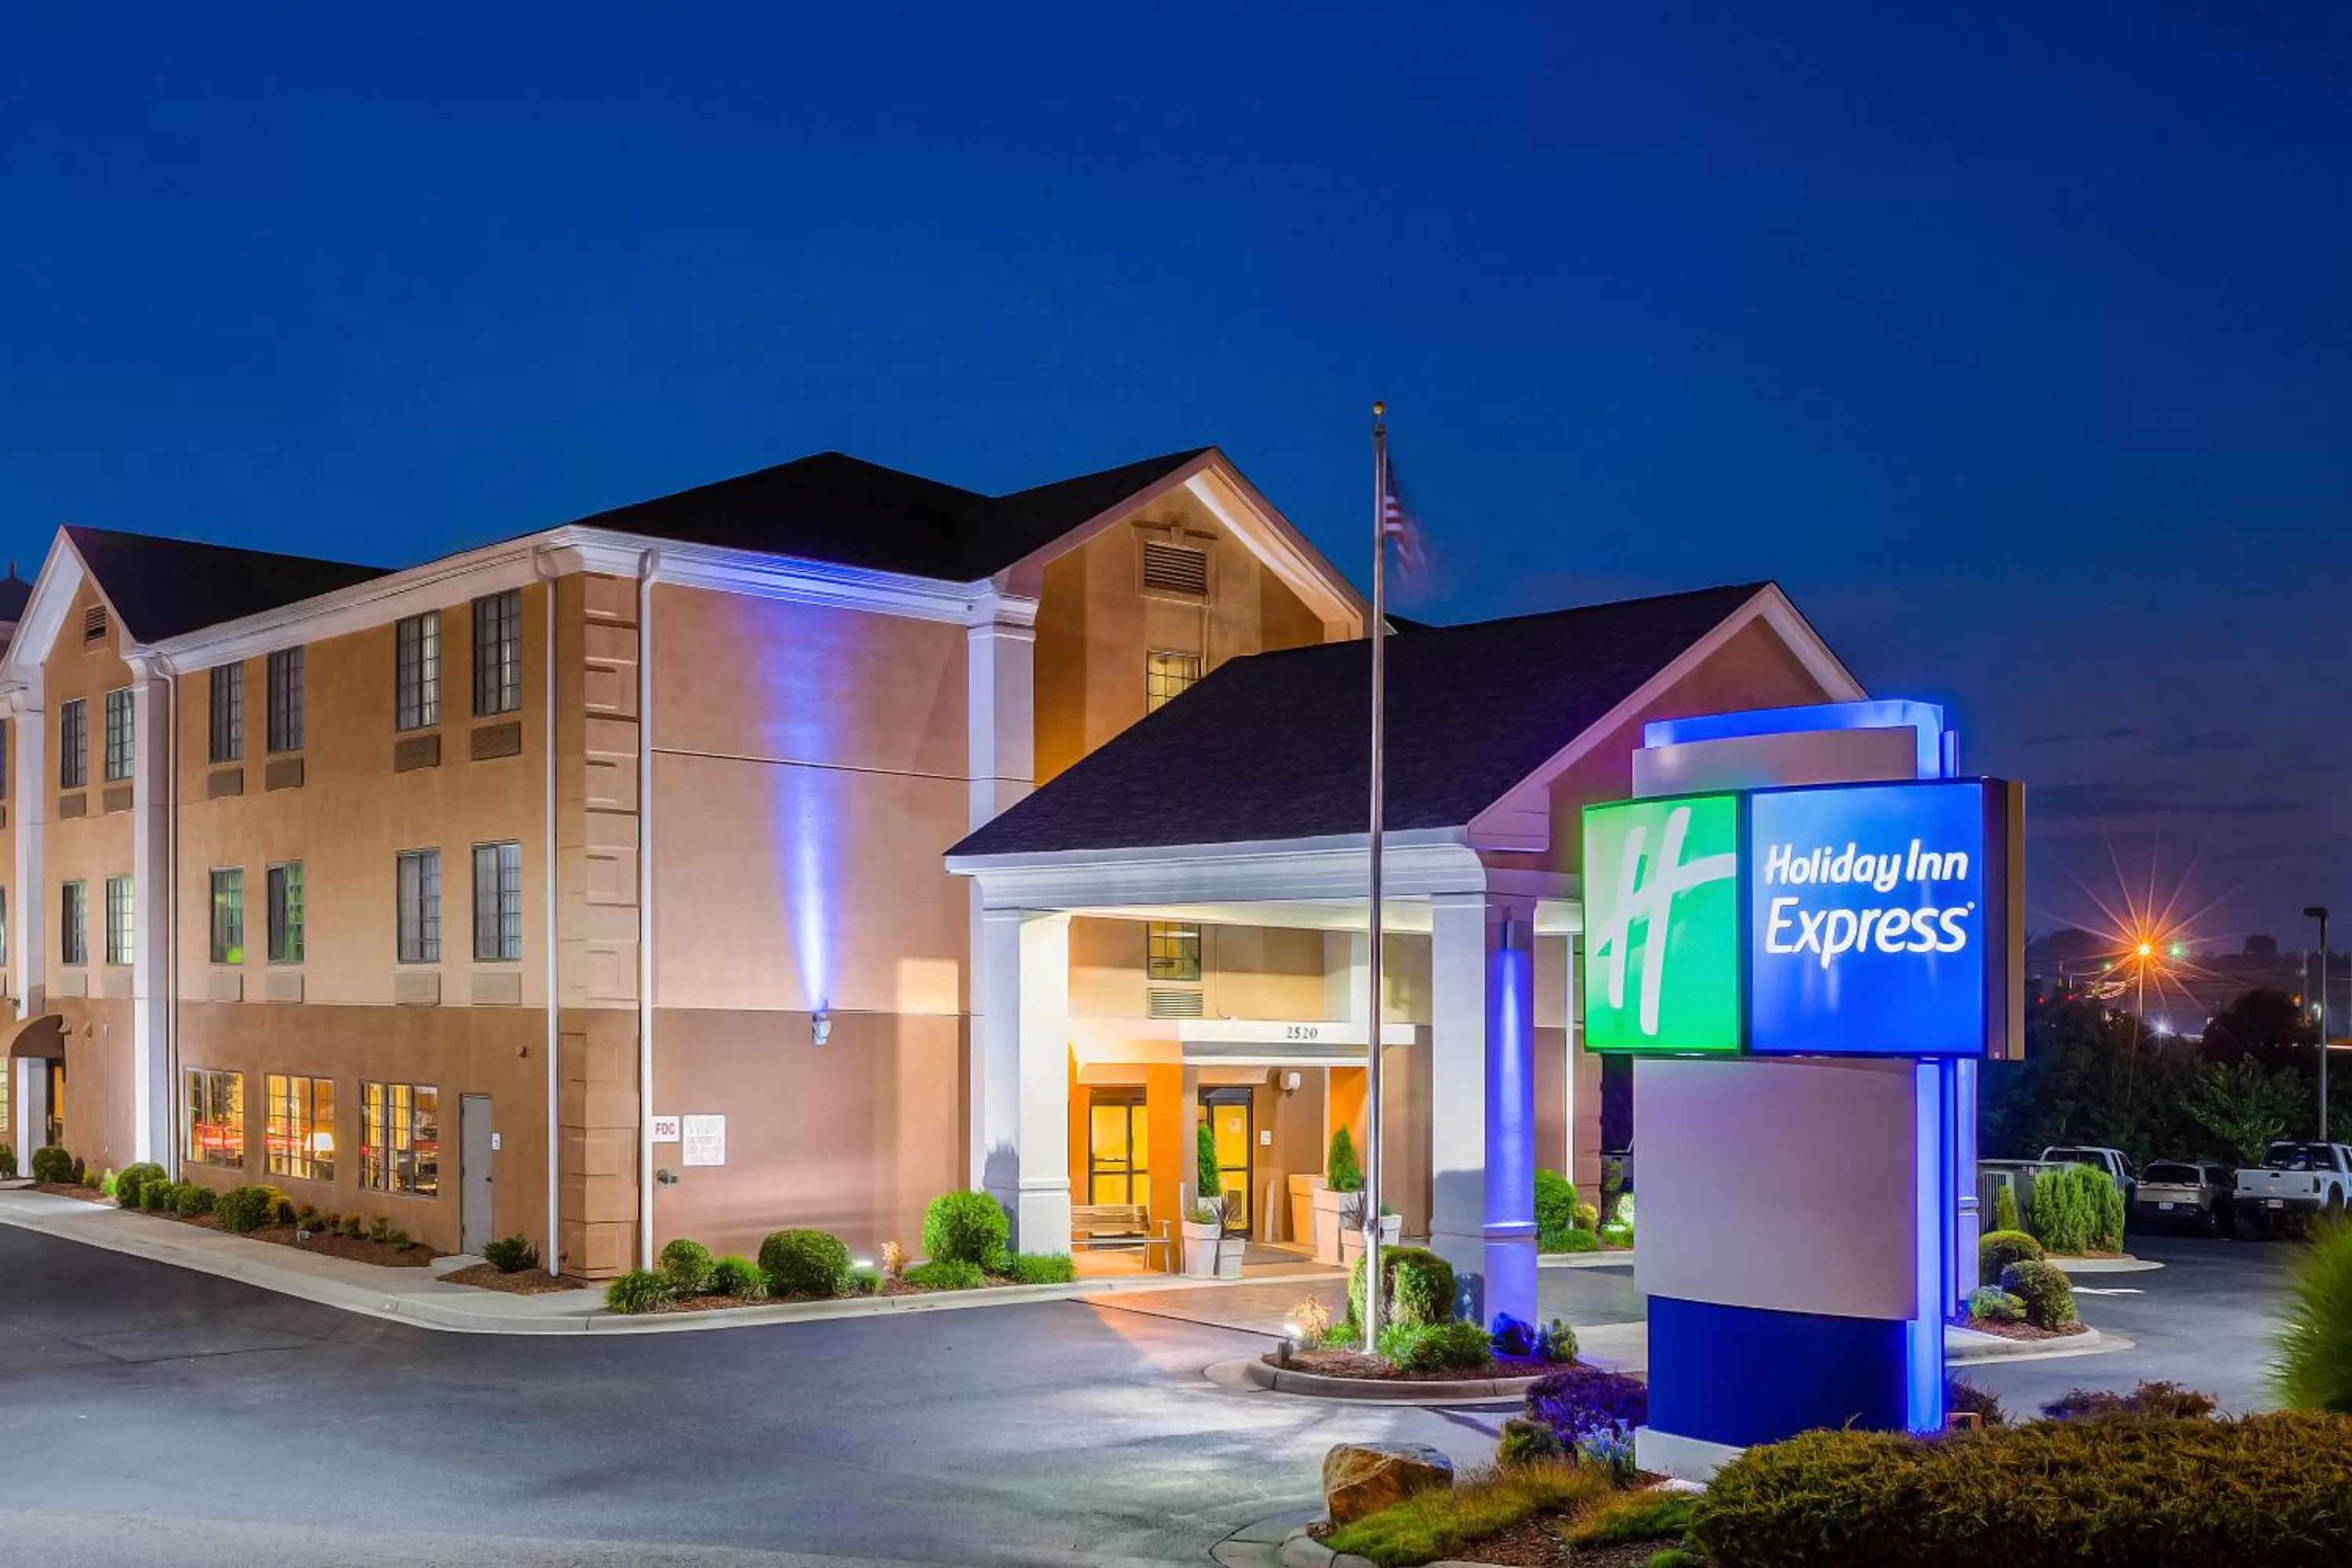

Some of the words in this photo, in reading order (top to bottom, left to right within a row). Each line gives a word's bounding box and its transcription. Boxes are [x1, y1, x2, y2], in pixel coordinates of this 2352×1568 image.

[1764, 842, 1902, 893] Holiday
[1906, 838, 1969, 882] Inn
[1765, 896, 1970, 969] Express
[1287, 1026, 1318, 1040] 2520
[655, 1122, 675, 1135] FDC
